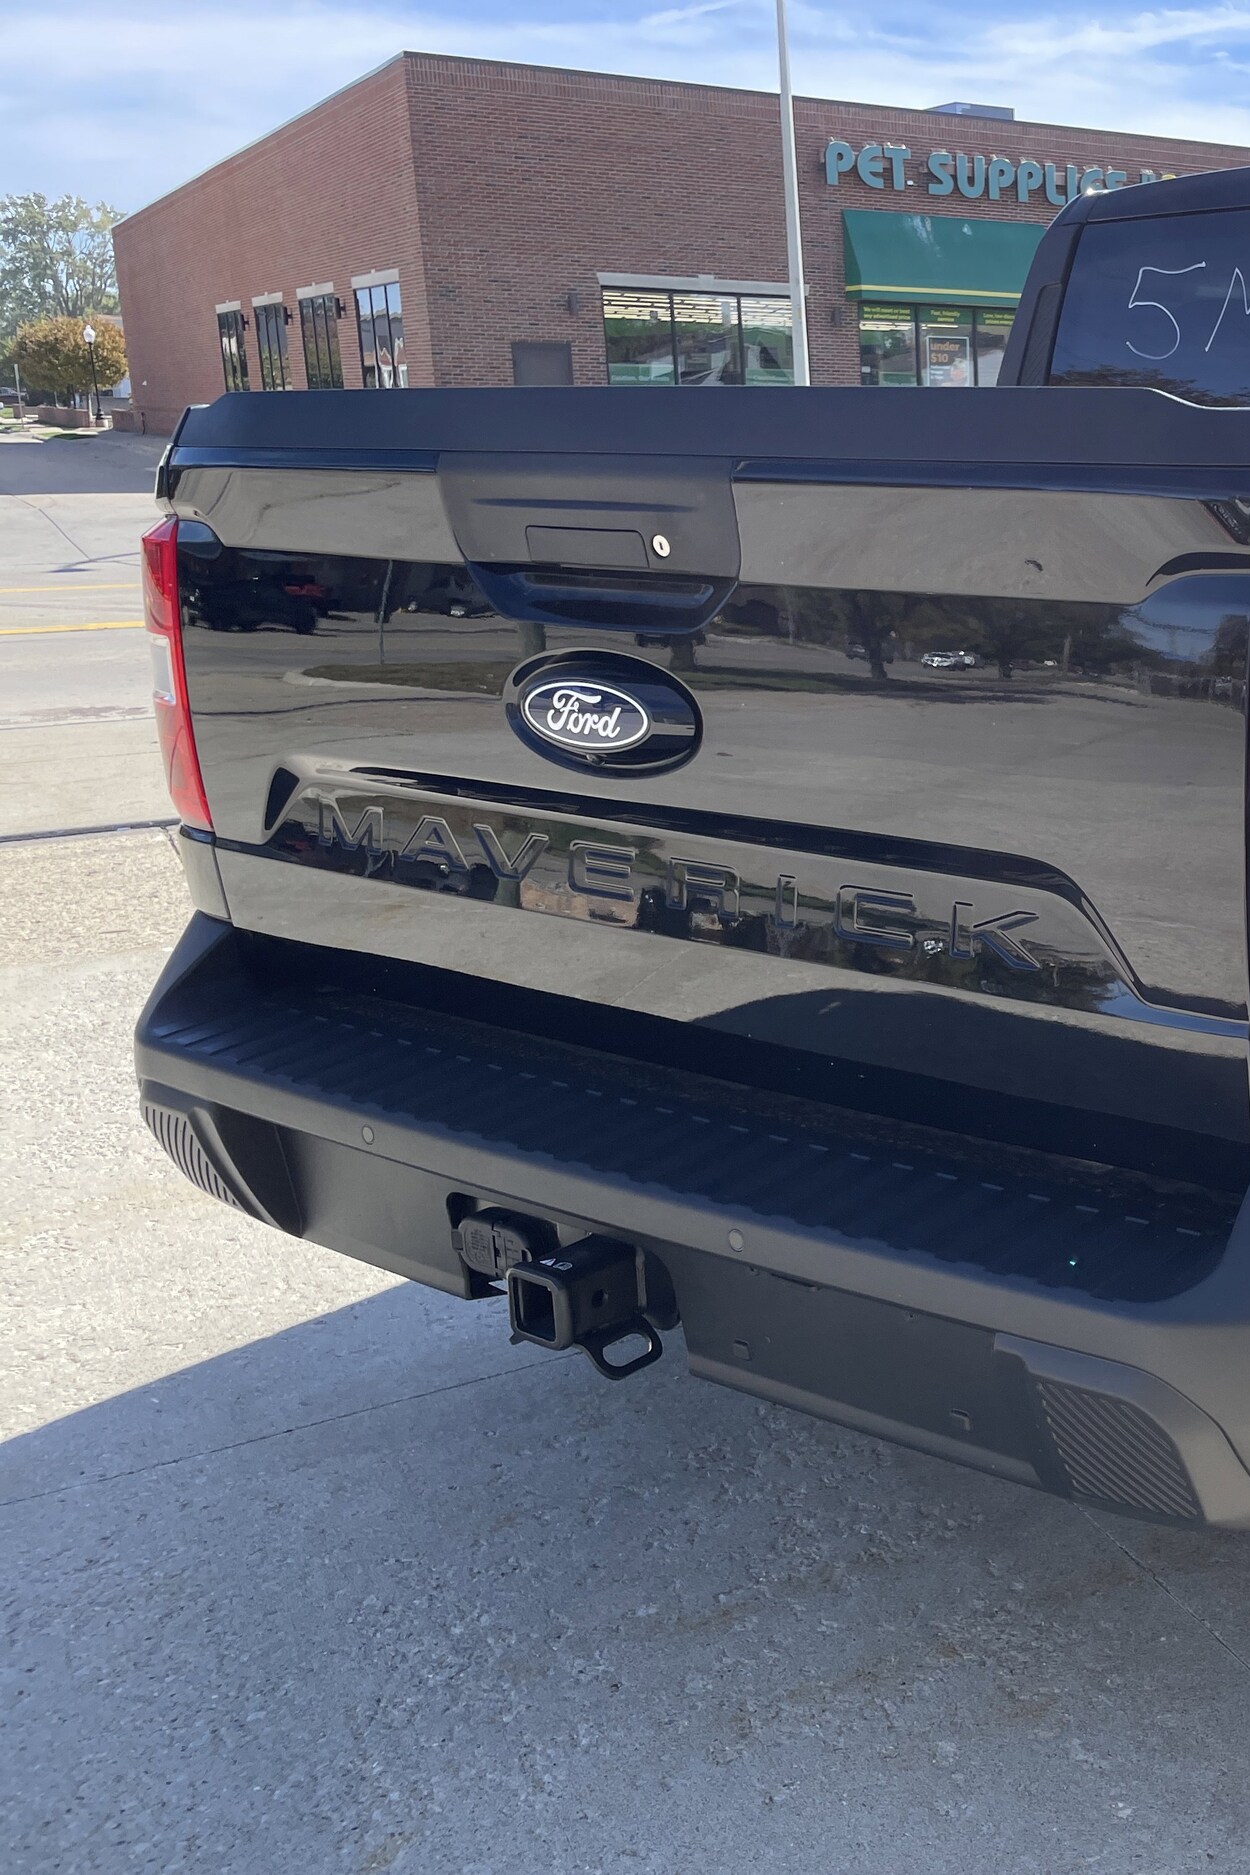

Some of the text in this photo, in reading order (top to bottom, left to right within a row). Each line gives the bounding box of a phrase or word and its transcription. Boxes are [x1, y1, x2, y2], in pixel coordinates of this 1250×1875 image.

[825, 140, 912, 191] PET
[930, 341, 960, 352] under
[930, 352, 949, 363] $10
[546, 689, 622, 739] Ford
[314, 797, 1043, 972] MAVERICK
